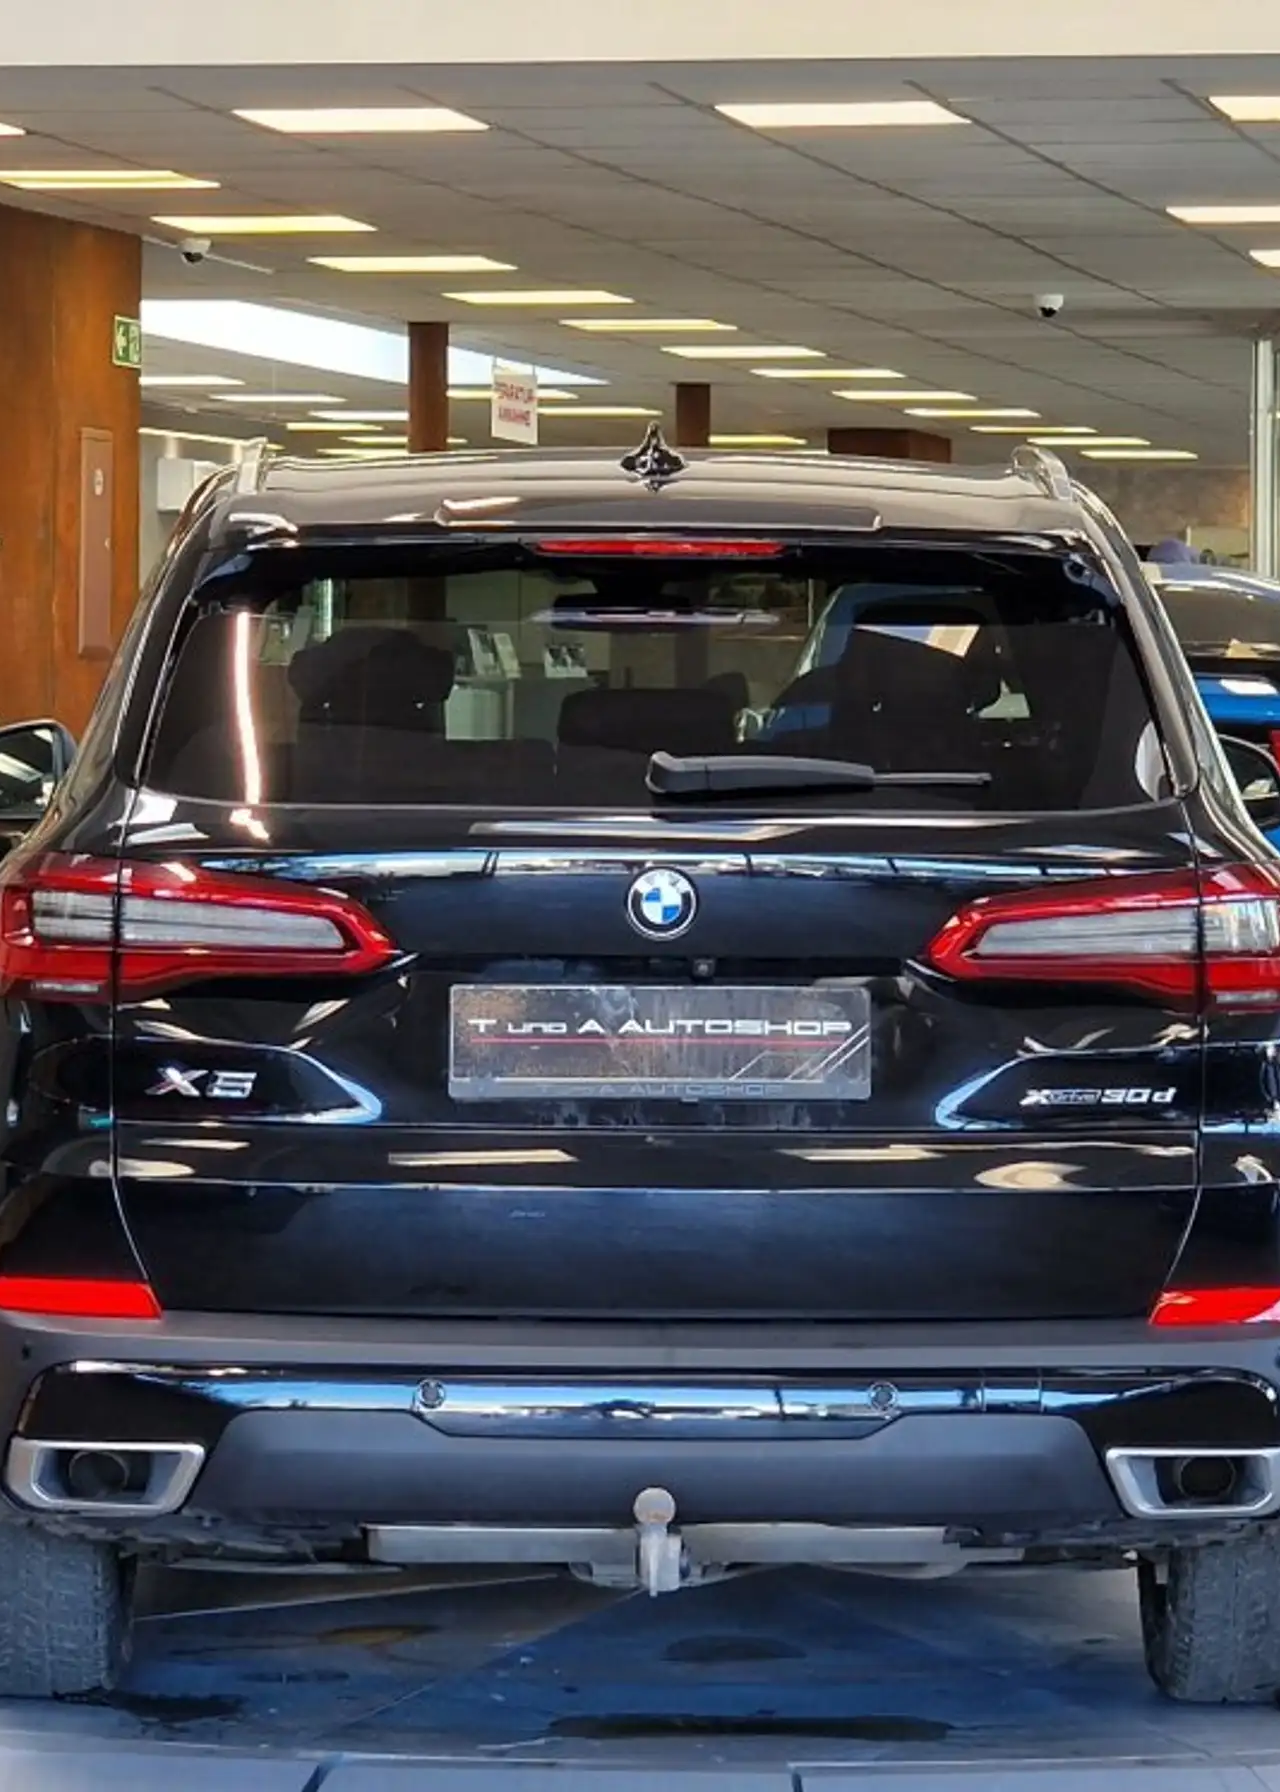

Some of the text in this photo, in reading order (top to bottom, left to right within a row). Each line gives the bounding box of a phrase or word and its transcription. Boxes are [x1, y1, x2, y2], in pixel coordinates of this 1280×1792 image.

[467, 1018, 498, 1034] T
[577, 1018, 607, 1035] A
[618, 1018, 853, 1037] AUTOSHOP
[143, 1066, 258, 1098] X5
